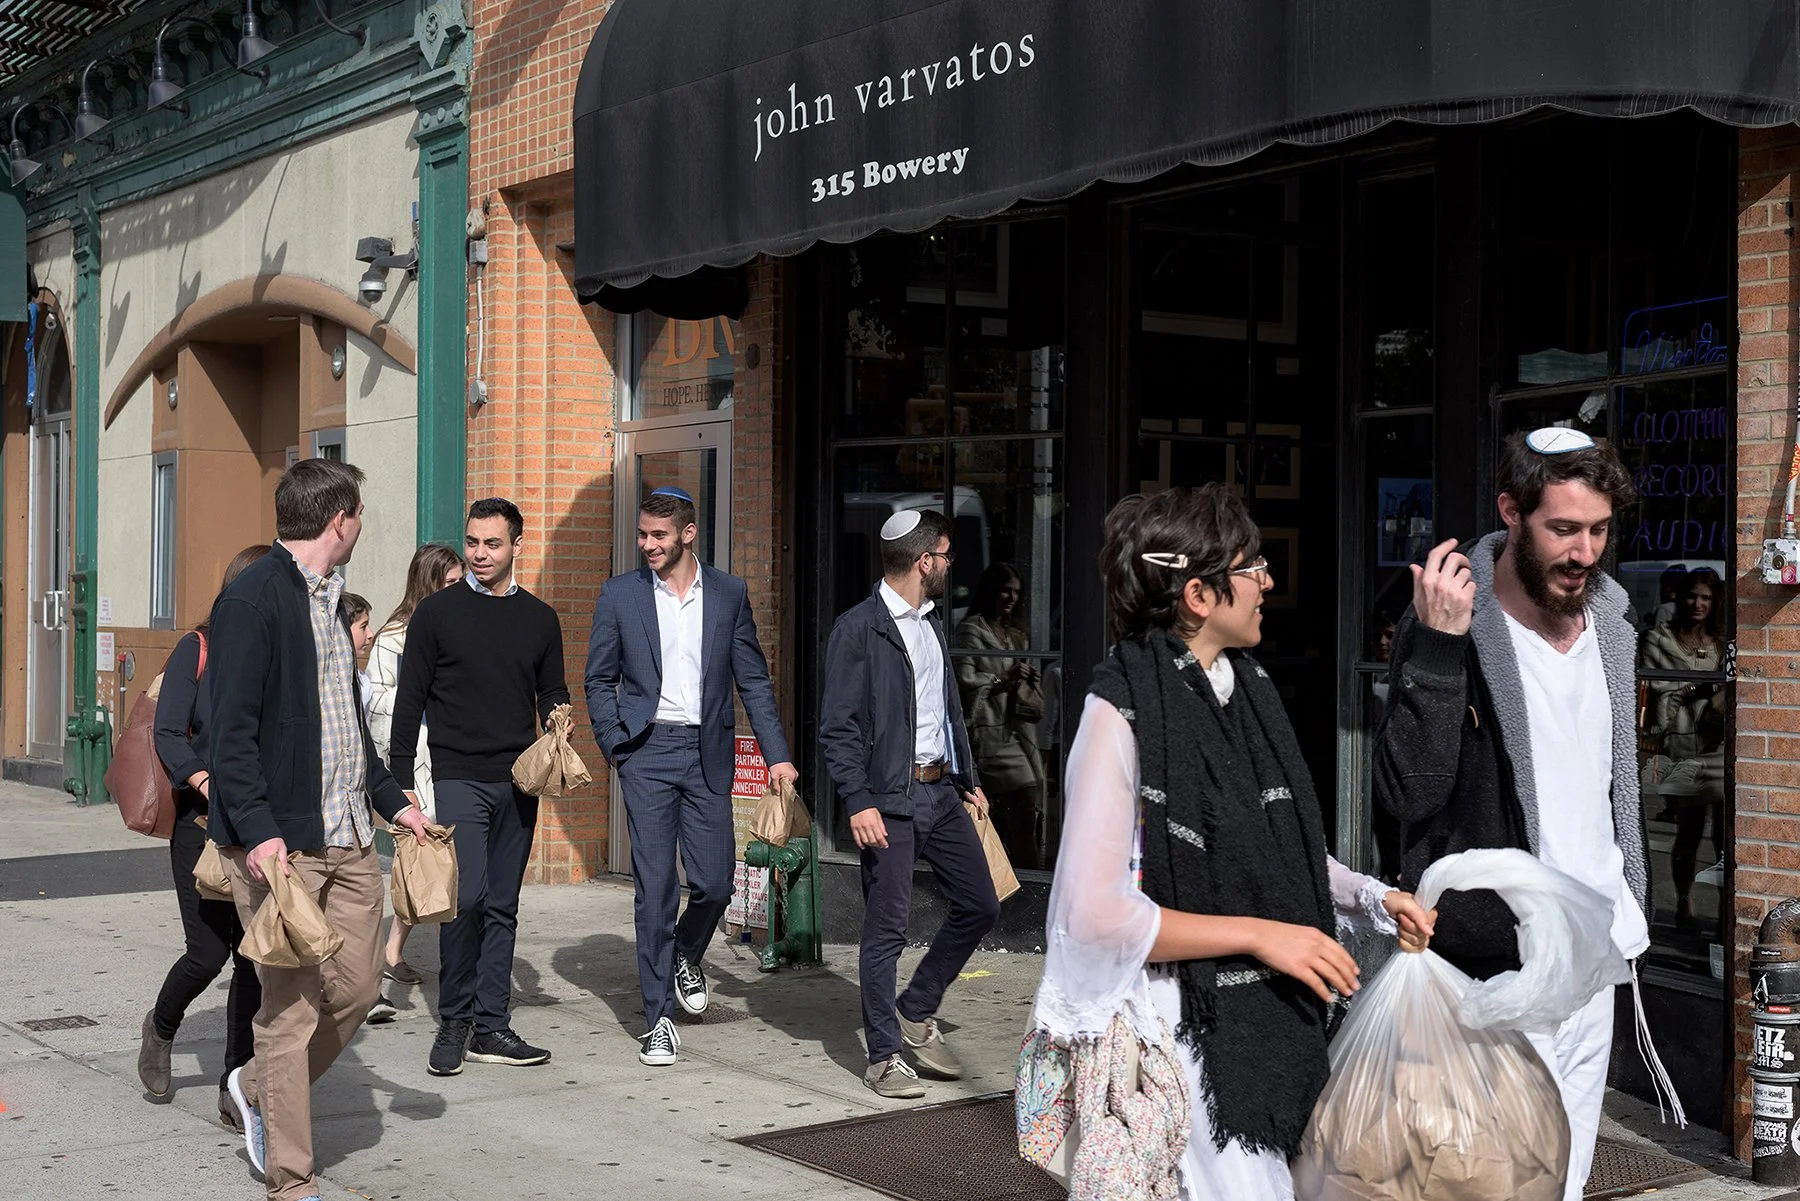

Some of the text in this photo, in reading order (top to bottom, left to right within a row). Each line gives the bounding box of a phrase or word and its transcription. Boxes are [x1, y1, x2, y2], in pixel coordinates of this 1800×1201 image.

[753, 33, 1036, 162] john varvatos
[811, 147, 970, 203] 315 Bowery
[740, 740, 754, 752] FIRE
[735, 754, 767, 767] PARTMEN
[734, 768, 765, 781] PRINKLER
[1755, 1024, 1786, 1044] ETZ
